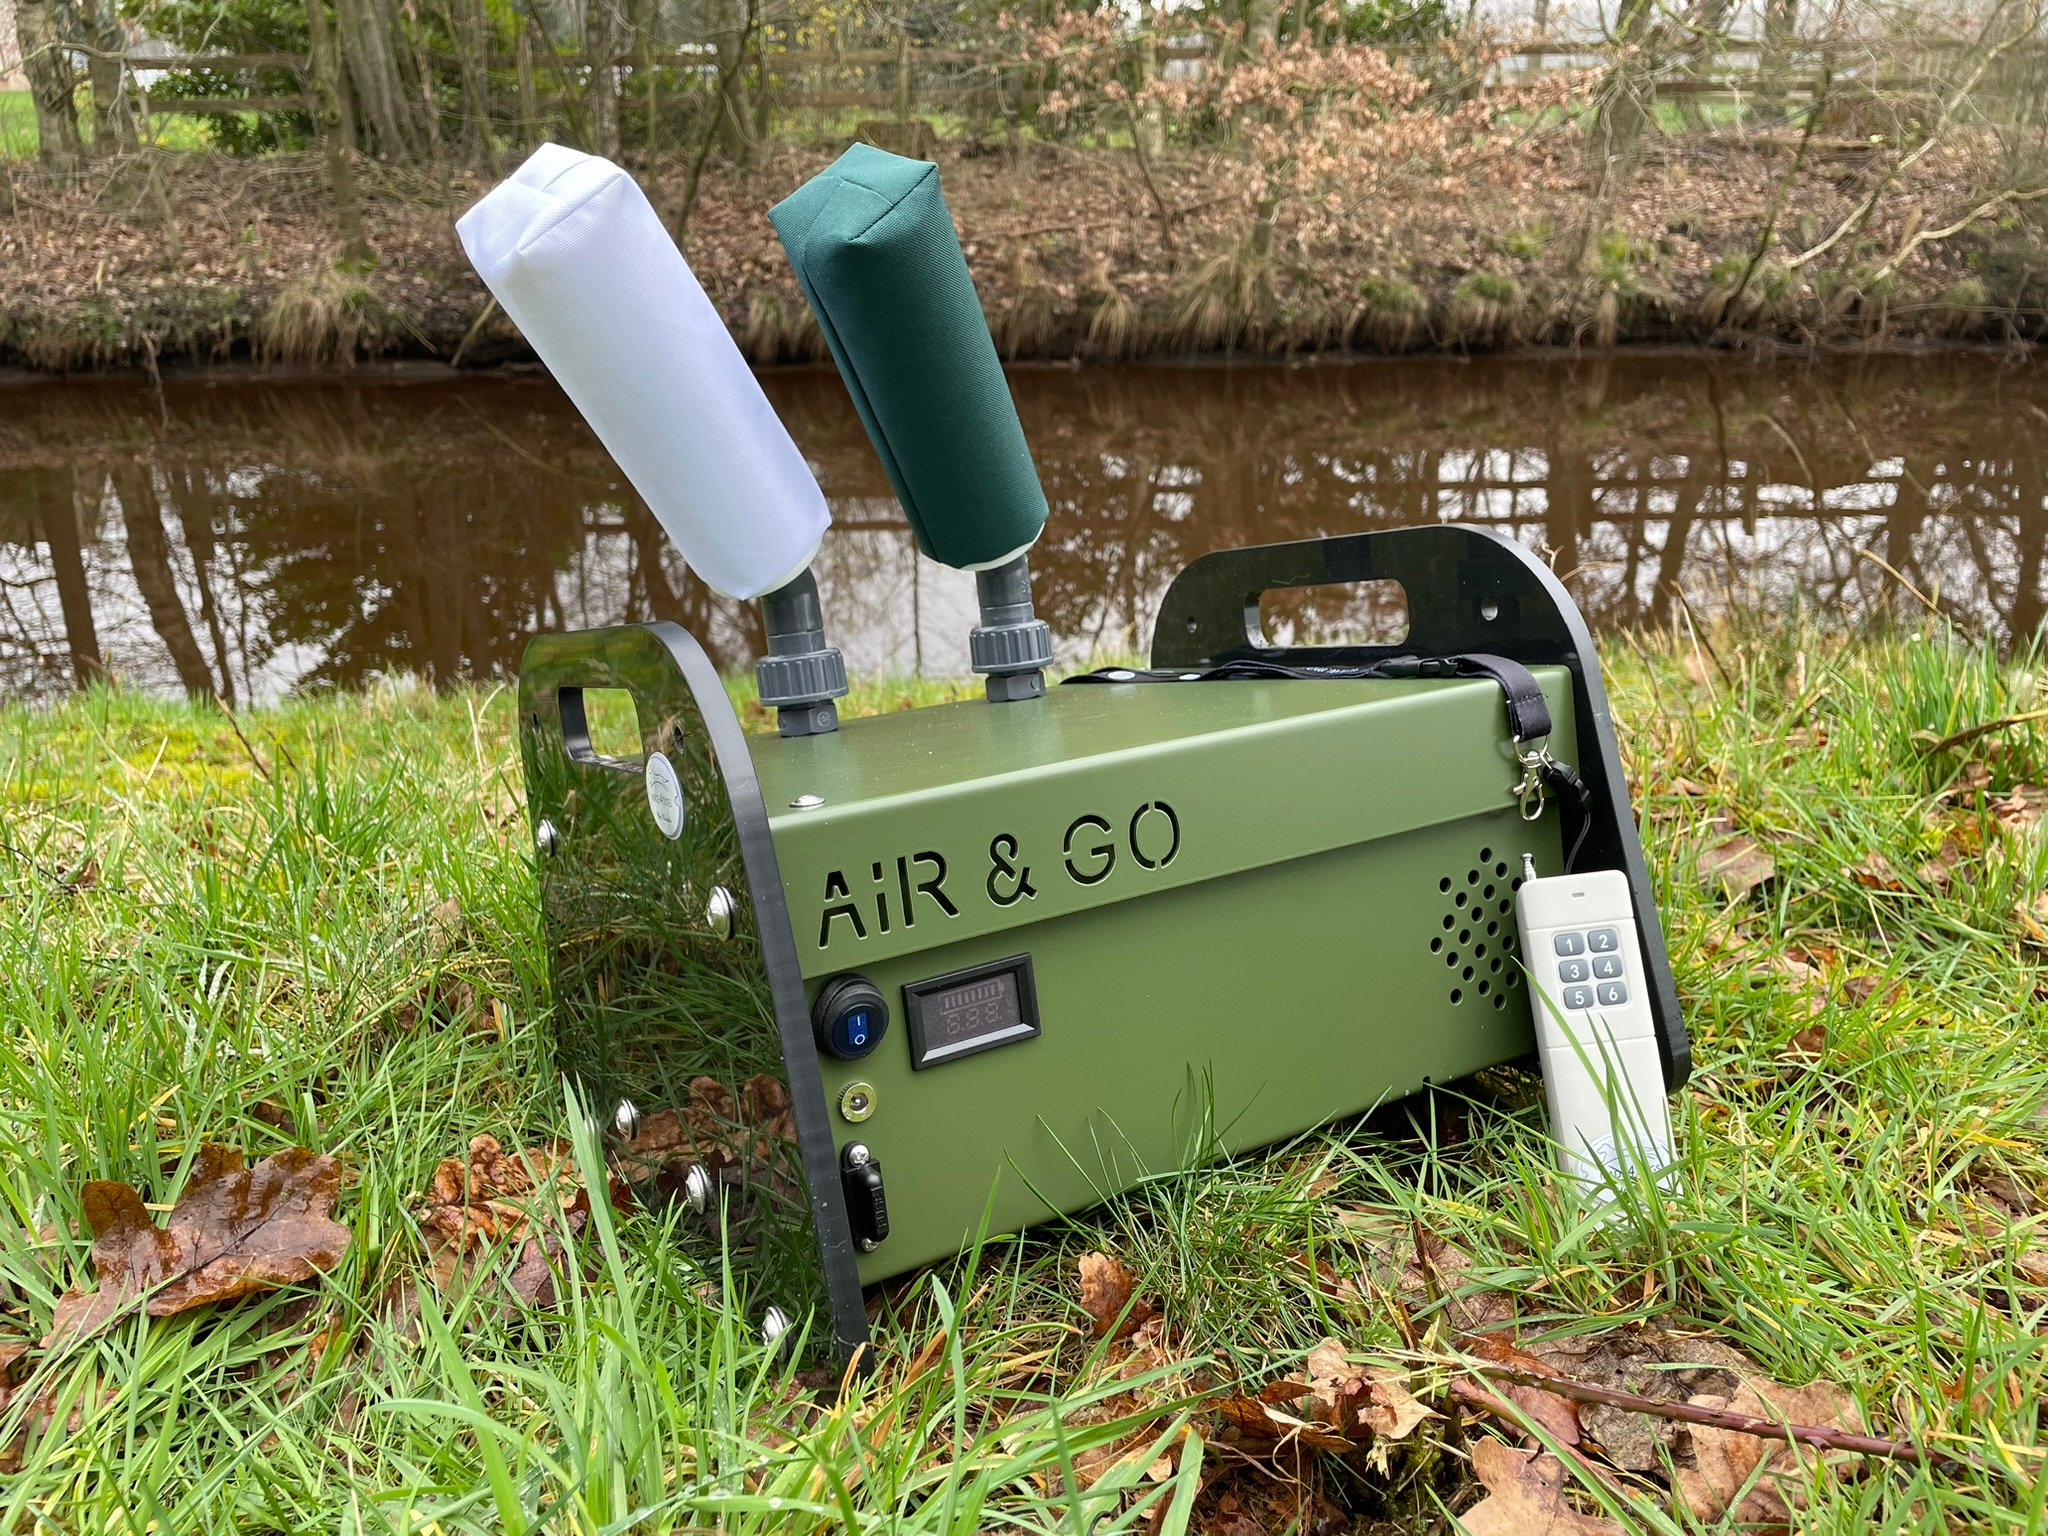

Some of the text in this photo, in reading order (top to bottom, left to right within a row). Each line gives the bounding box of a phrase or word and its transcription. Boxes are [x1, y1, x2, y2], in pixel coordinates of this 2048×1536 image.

[986, 833, 1038, 908] &
[1063, 800, 1181, 887] GO
[1566, 934, 1609, 952] 1 2
[1570, 960, 1614, 979] 3 4
[1575, 986, 1618, 1005] 5 6
